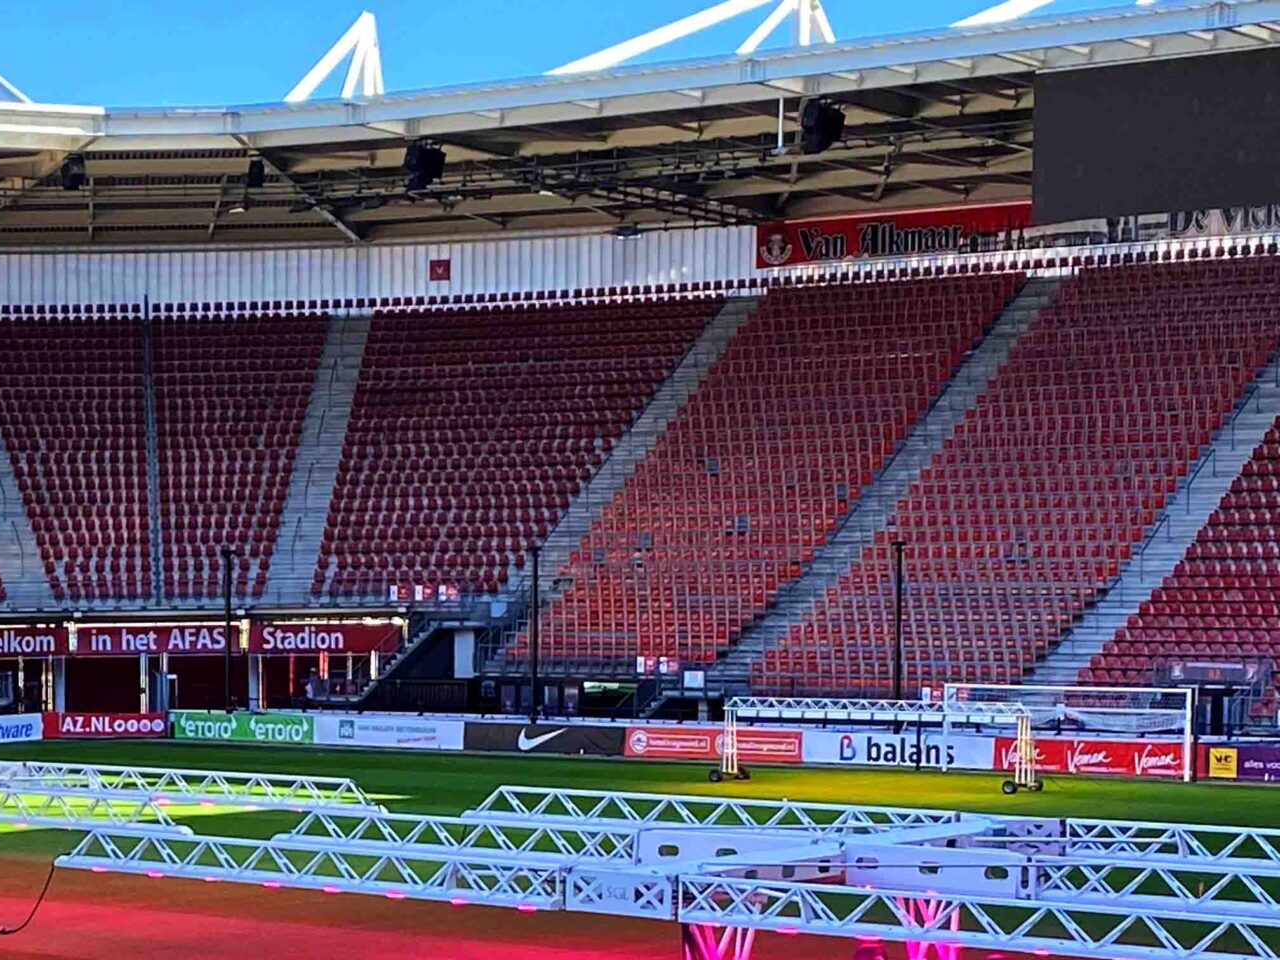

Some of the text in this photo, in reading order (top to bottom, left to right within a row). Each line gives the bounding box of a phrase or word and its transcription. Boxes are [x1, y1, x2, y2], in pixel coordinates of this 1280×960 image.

[797, 221, 963, 261] Van Alkmaar
[91, 629, 112, 651] in
[122, 629, 157, 651] het
[168, 628, 226, 650] AFAS
[261, 626, 344, 650] Stadion
[867, 736, 955, 766] balans
